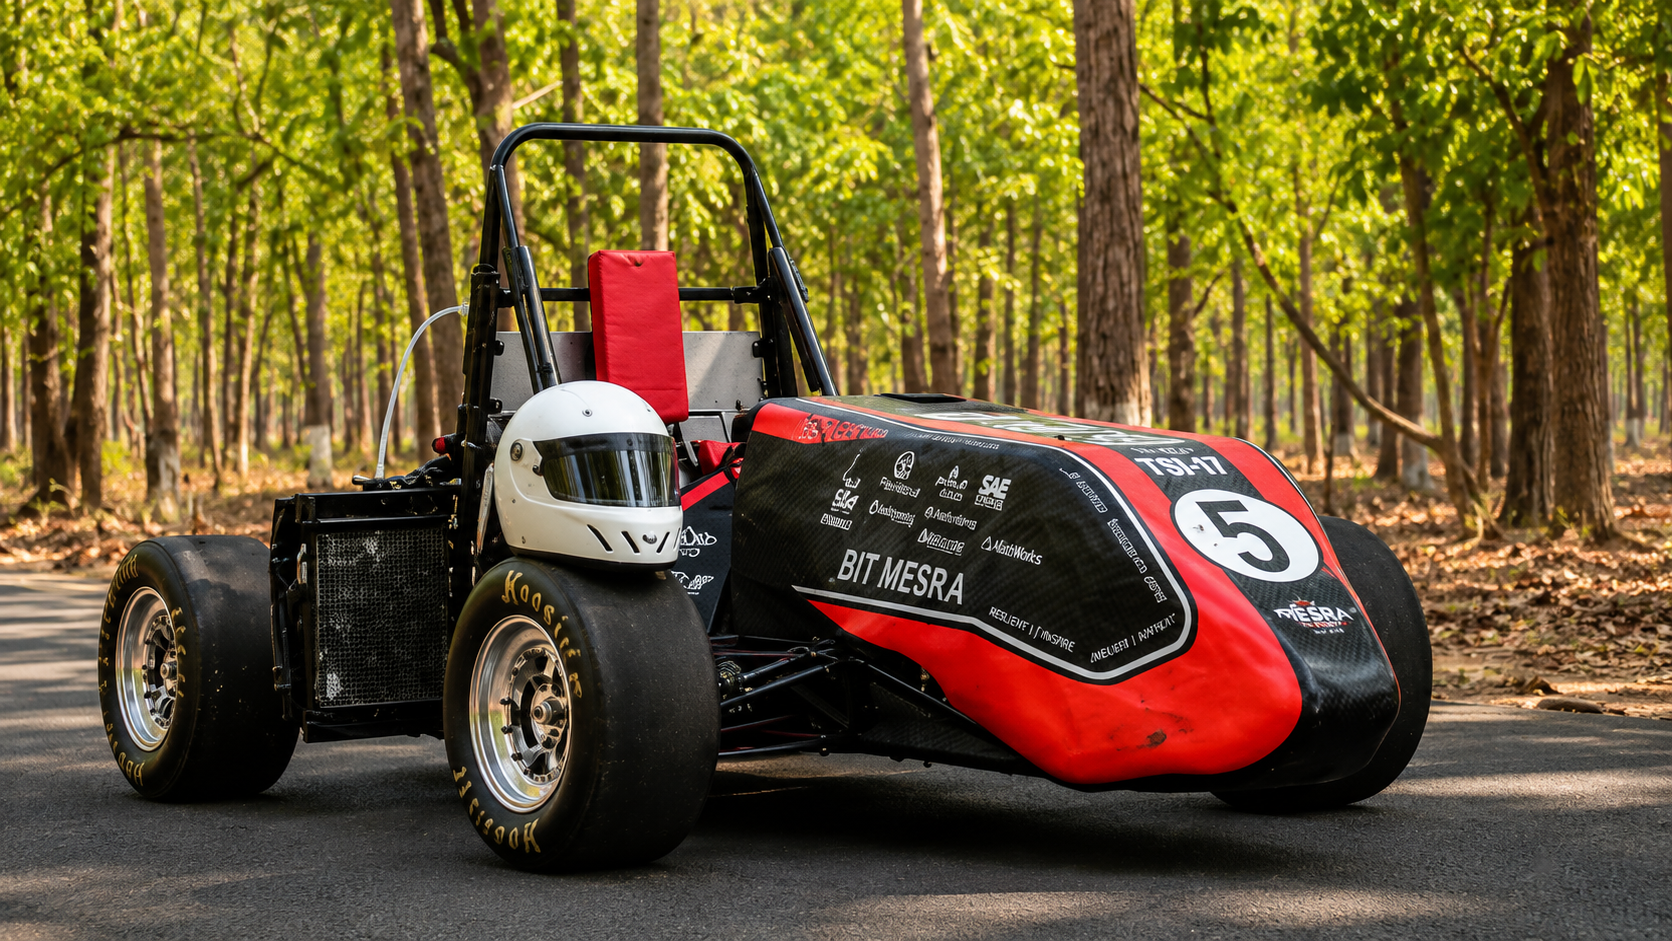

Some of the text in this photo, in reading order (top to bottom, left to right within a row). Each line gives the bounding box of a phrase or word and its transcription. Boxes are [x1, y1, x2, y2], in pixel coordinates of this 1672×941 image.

[1134, 455, 1228, 476] TSI-17
[978, 474, 1012, 500] SAE
[1195, 499, 1290, 573] 5
[837, 548, 966, 605] BIT MESRA
